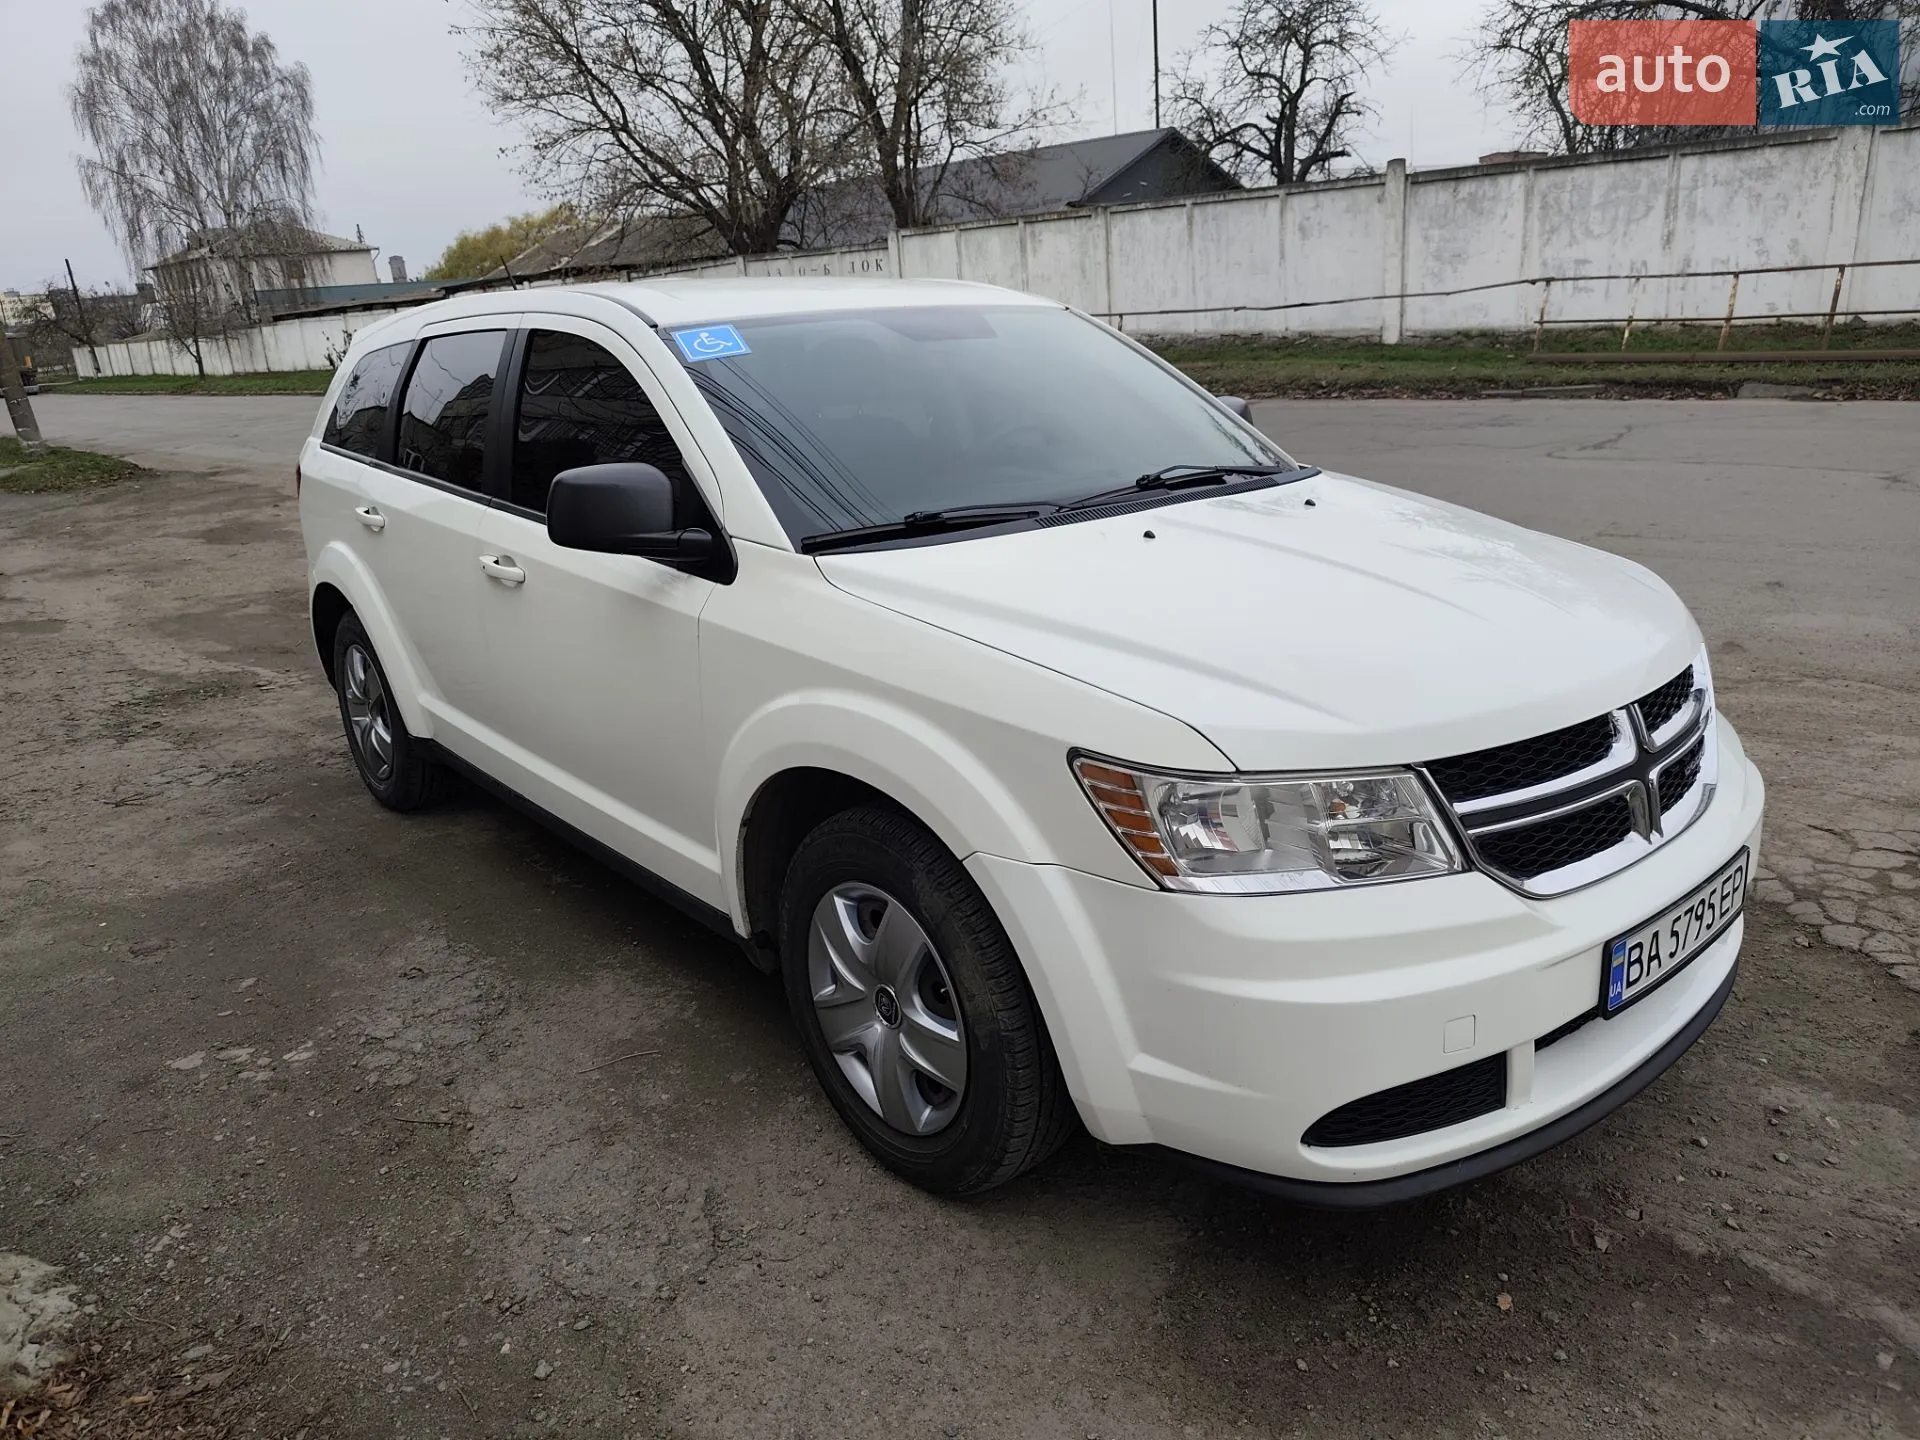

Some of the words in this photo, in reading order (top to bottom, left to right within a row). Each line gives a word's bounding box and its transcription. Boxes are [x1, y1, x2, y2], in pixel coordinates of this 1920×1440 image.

[1626, 929, 1662, 989] BA
[1669, 887, 1717, 960] 5795
[1719, 864, 1744, 921] EP
[1610, 982, 1622, 997] UA
